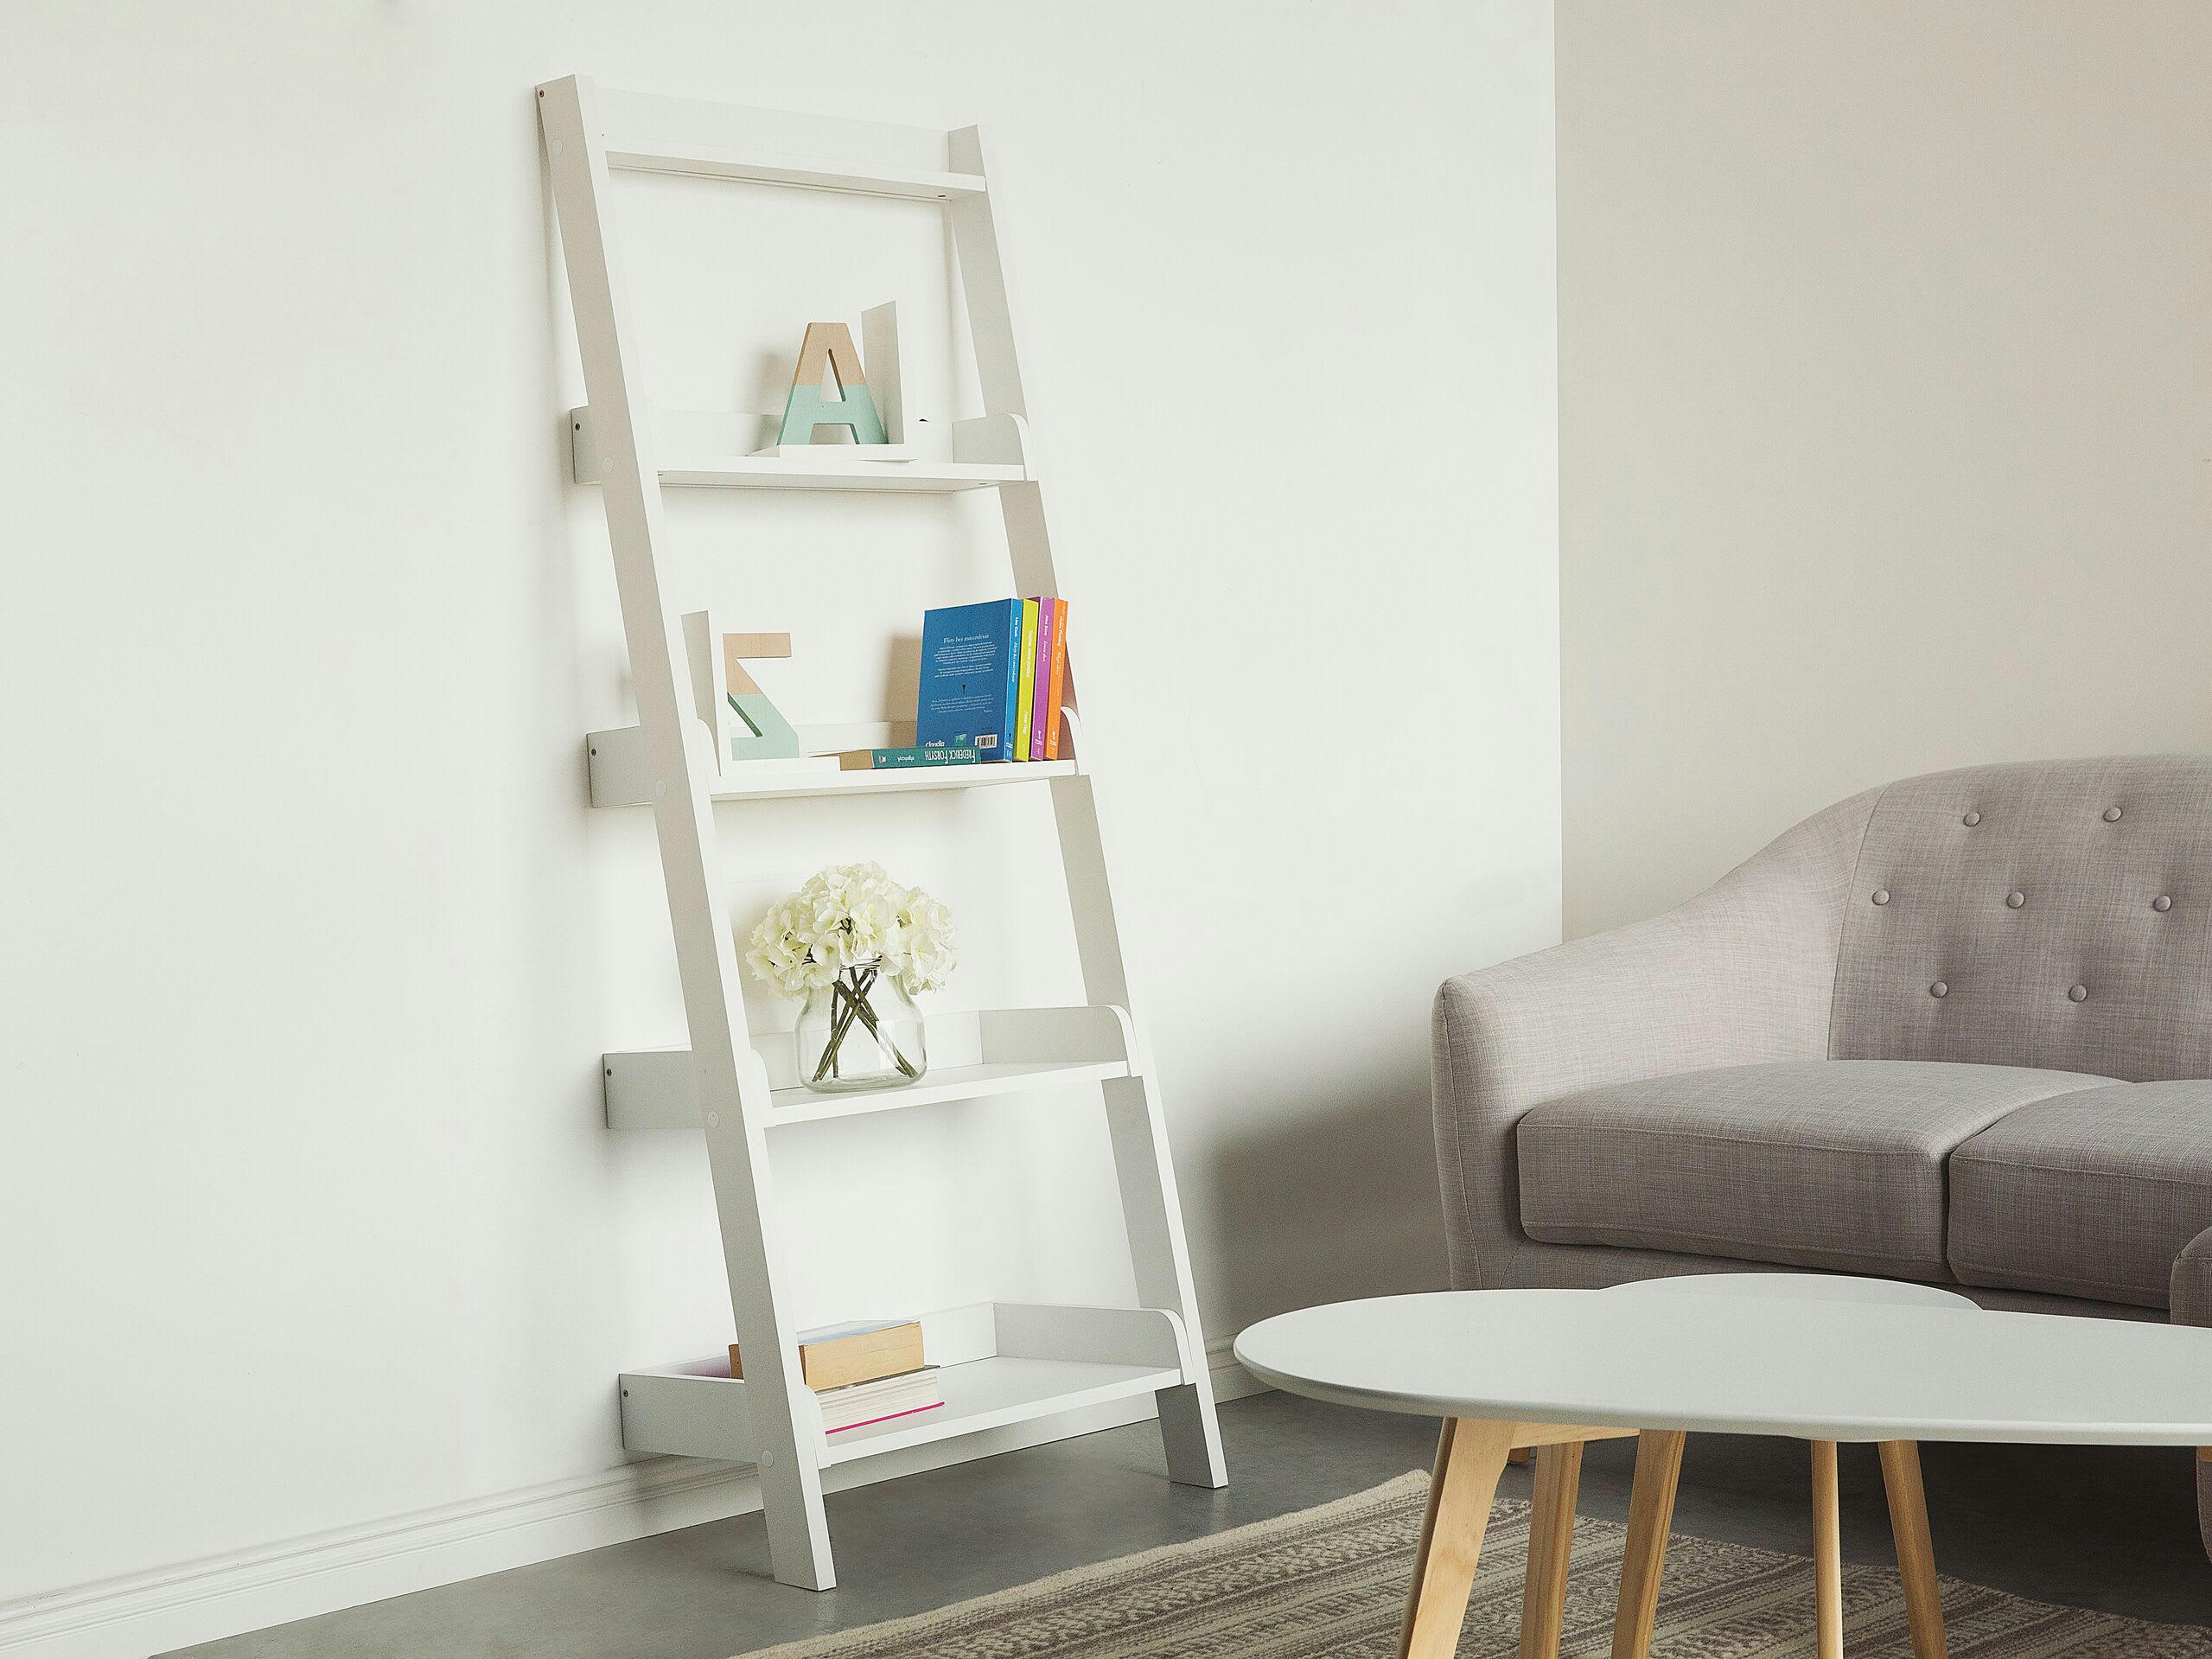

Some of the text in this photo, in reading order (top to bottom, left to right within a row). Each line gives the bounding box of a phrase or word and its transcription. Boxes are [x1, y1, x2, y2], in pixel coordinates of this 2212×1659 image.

[776, 322, 889, 445] A
[924, 749, 976, 764] FREDERICK FORSYTH
